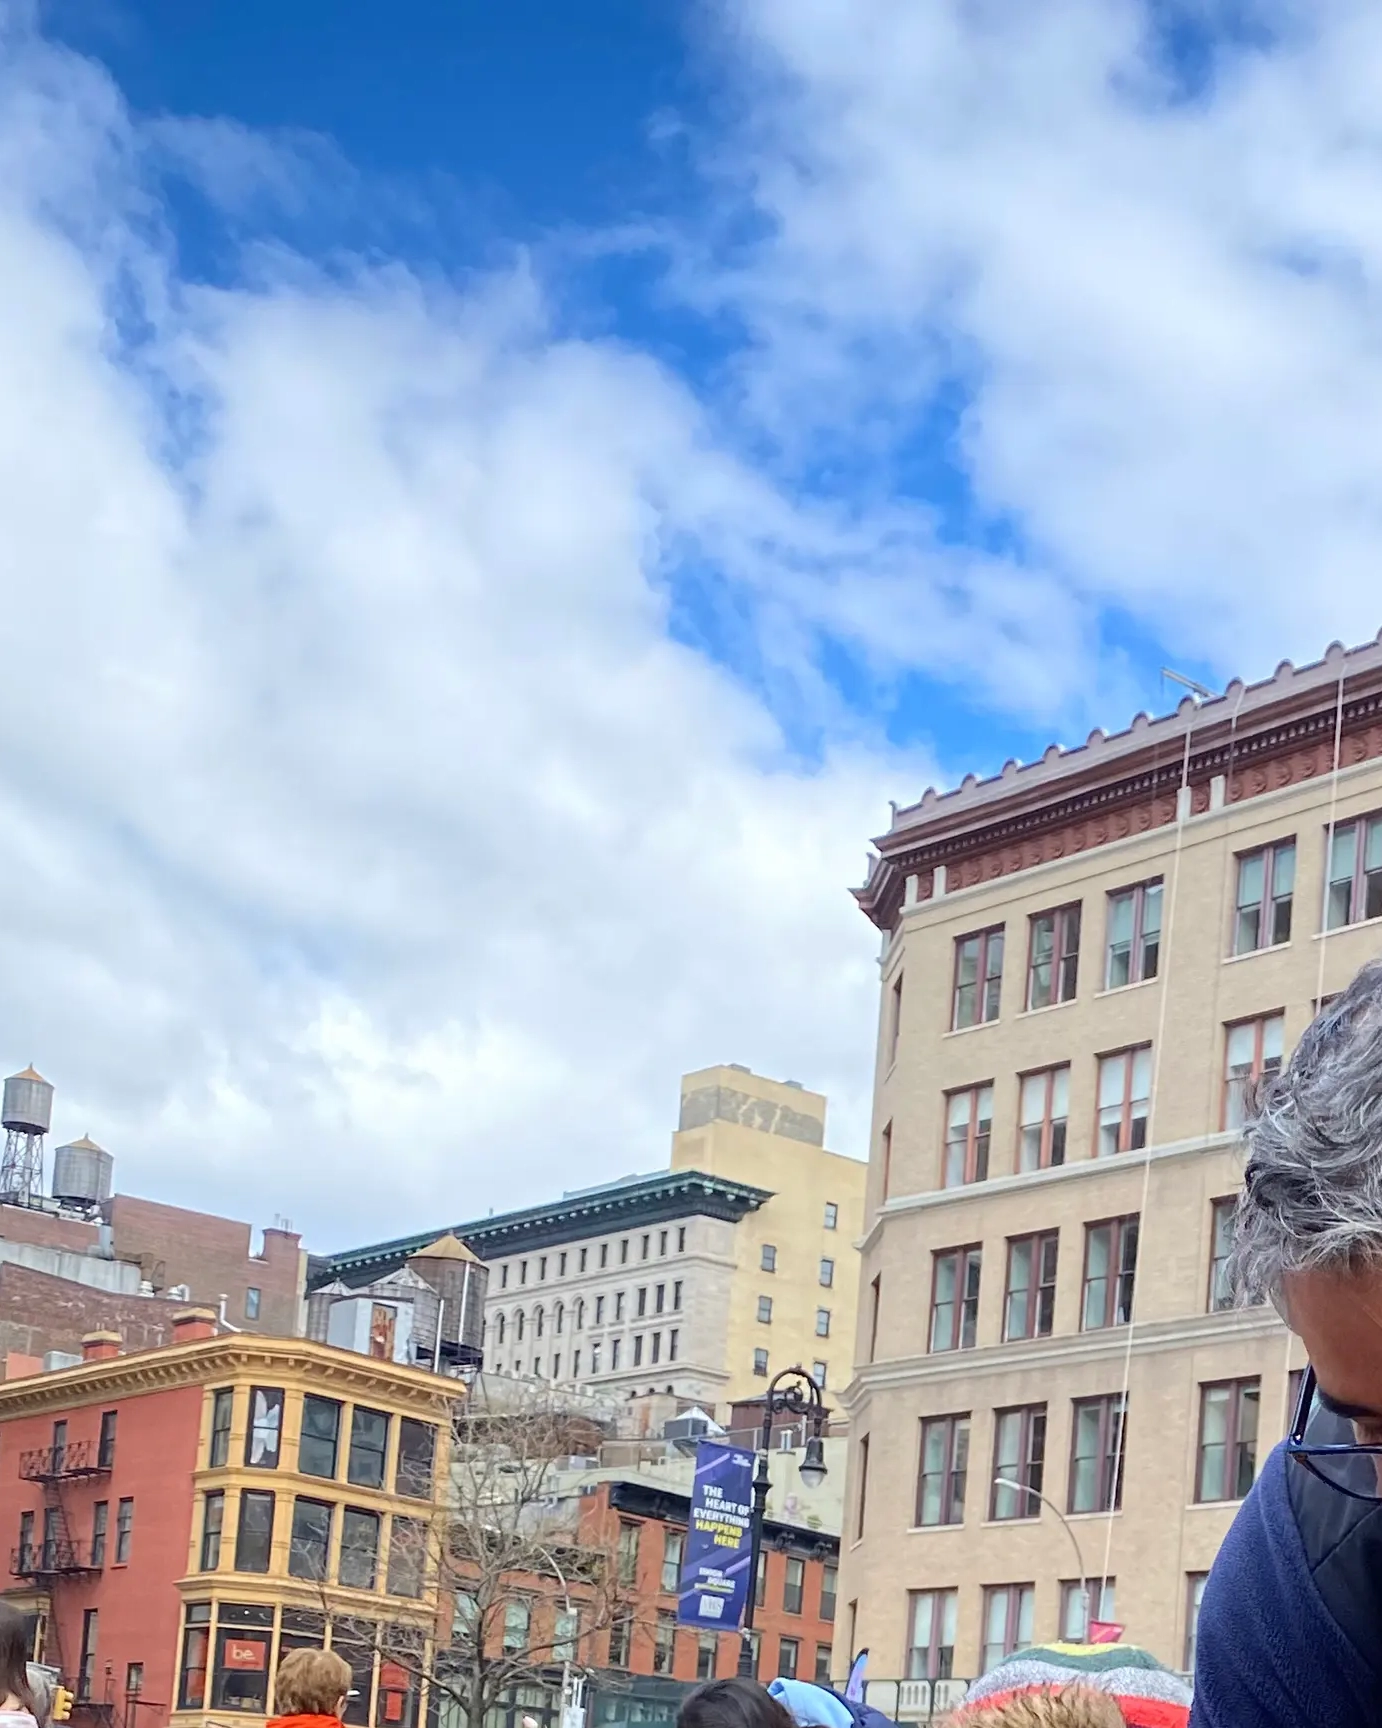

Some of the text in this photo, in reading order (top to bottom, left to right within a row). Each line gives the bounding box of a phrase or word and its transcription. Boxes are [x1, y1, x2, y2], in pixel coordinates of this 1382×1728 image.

[703, 1485, 723, 1498] THE
[705, 1497, 750, 1516] HEART OF
[693, 1507, 750, 1528] EVERYTHING
[696, 1519, 742, 1537] HAPPENS
[713, 1533, 739, 1549] HERE
